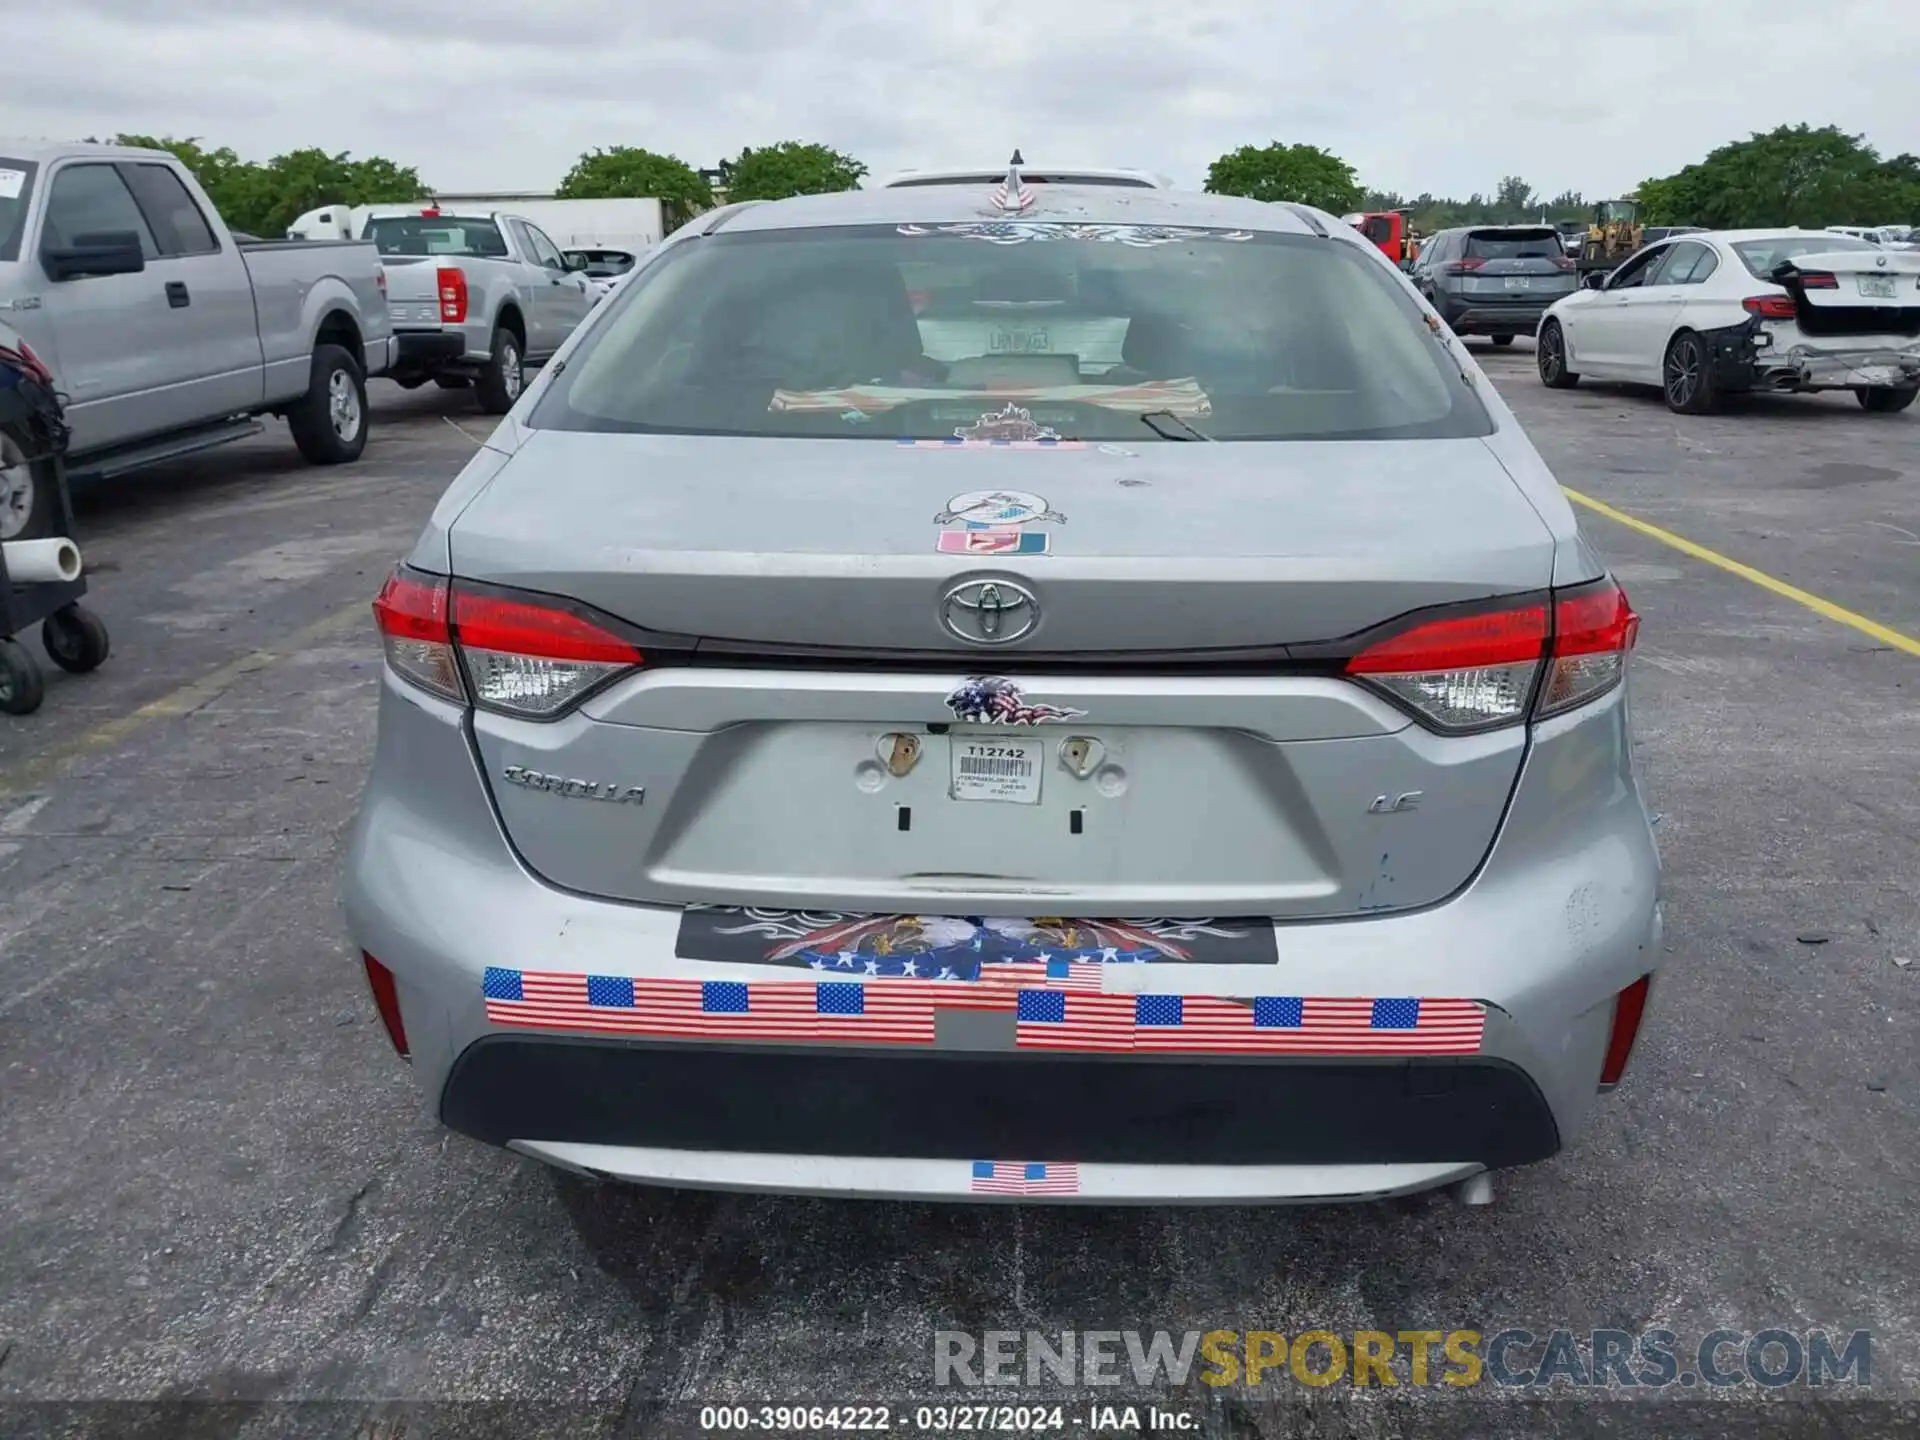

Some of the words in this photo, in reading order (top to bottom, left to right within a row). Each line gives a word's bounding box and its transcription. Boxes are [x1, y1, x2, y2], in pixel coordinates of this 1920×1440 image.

[967, 746, 1026, 759] T12742
[504, 765, 645, 805] COROLLA
[1368, 790, 1424, 814] LE
